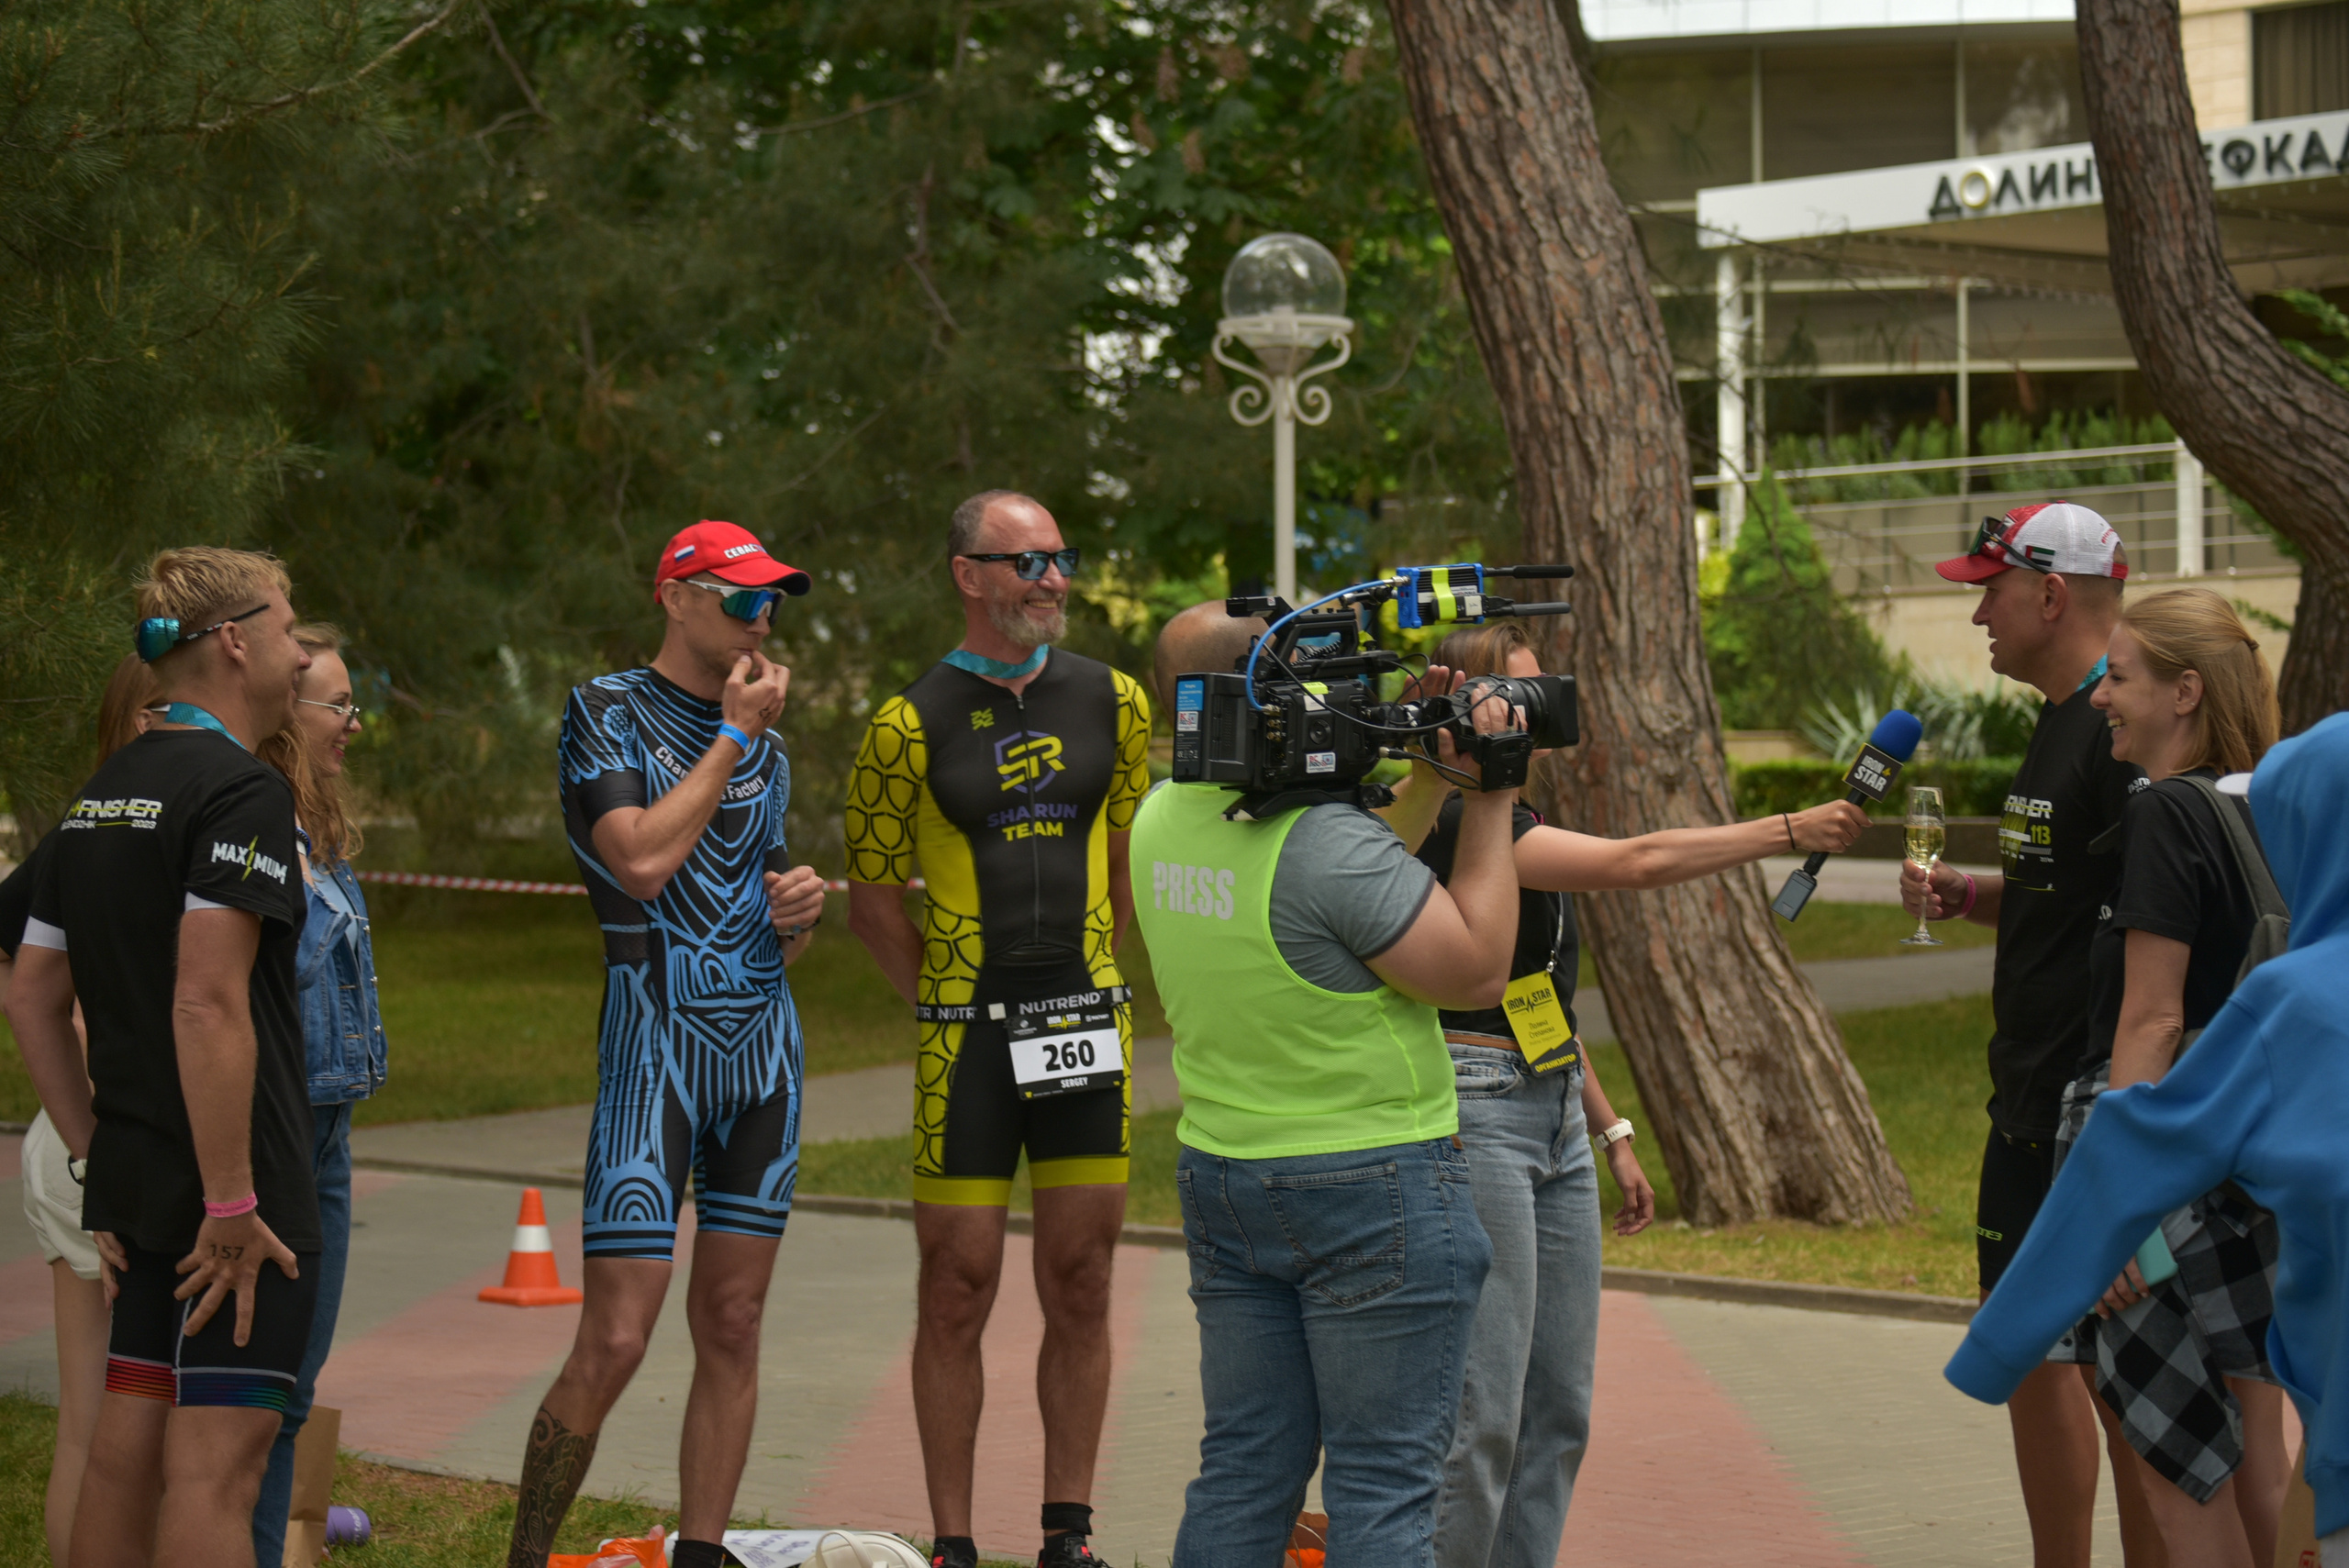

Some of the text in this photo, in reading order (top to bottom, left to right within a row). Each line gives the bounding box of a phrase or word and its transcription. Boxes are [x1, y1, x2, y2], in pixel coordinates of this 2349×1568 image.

[1929, 159, 2093, 217] ДОЛИН
[1861, 755, 1885, 774] IRON
[726, 774, 766, 800] Factory
[1854, 765, 1887, 793] STAR
[1002, 822, 1063, 841] TEAM
[2031, 825, 2052, 845] 113
[1153, 861, 1234, 920] PRESS
[1019, 992, 1100, 1015] NUTREND
[1507, 988, 1552, 1011] IRON STAR
[1042, 1040, 1095, 1072] 260
[1061, 1077, 1088, 1088] SERGEY
[210, 1245, 244, 1260] 157
